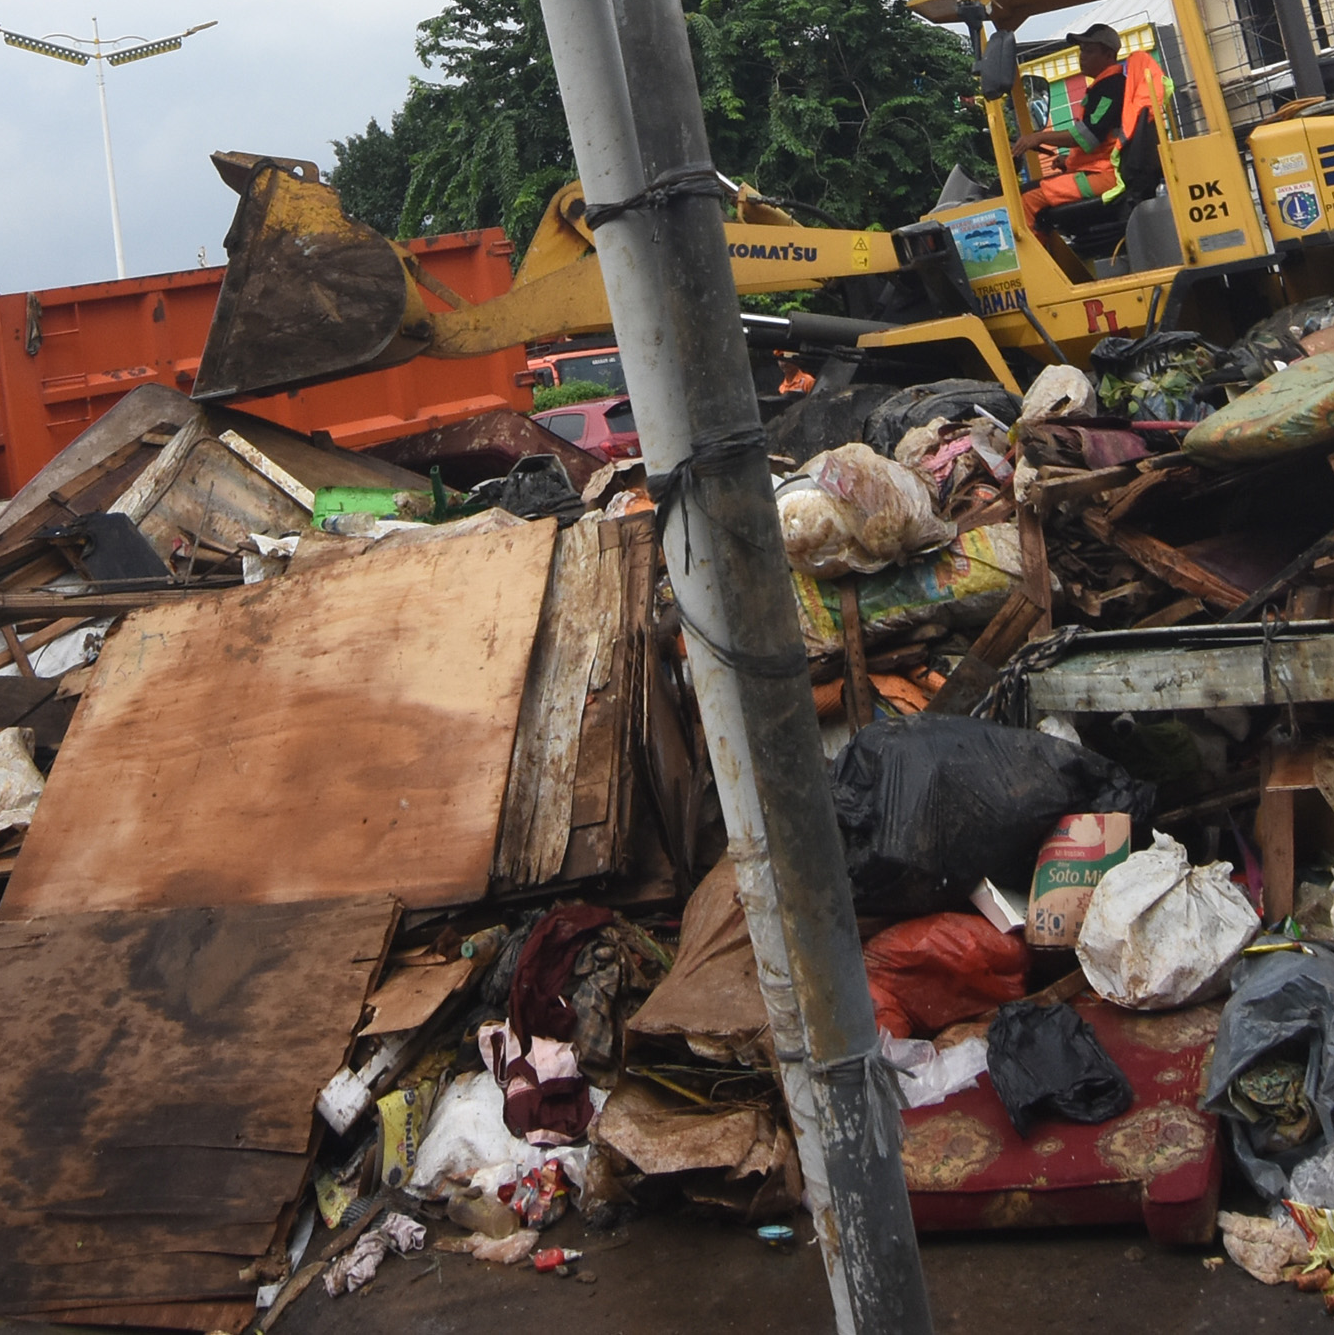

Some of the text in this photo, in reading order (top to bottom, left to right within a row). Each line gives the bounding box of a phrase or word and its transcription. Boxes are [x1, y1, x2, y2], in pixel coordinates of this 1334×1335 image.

[1188, 180, 1224, 201] DK
[1189, 202, 1230, 223] 021
[727, 242, 817, 263] KOMATSU
[977, 278, 1023, 297] TRACTORS
[1048, 867, 1103, 885] Soto Mi
